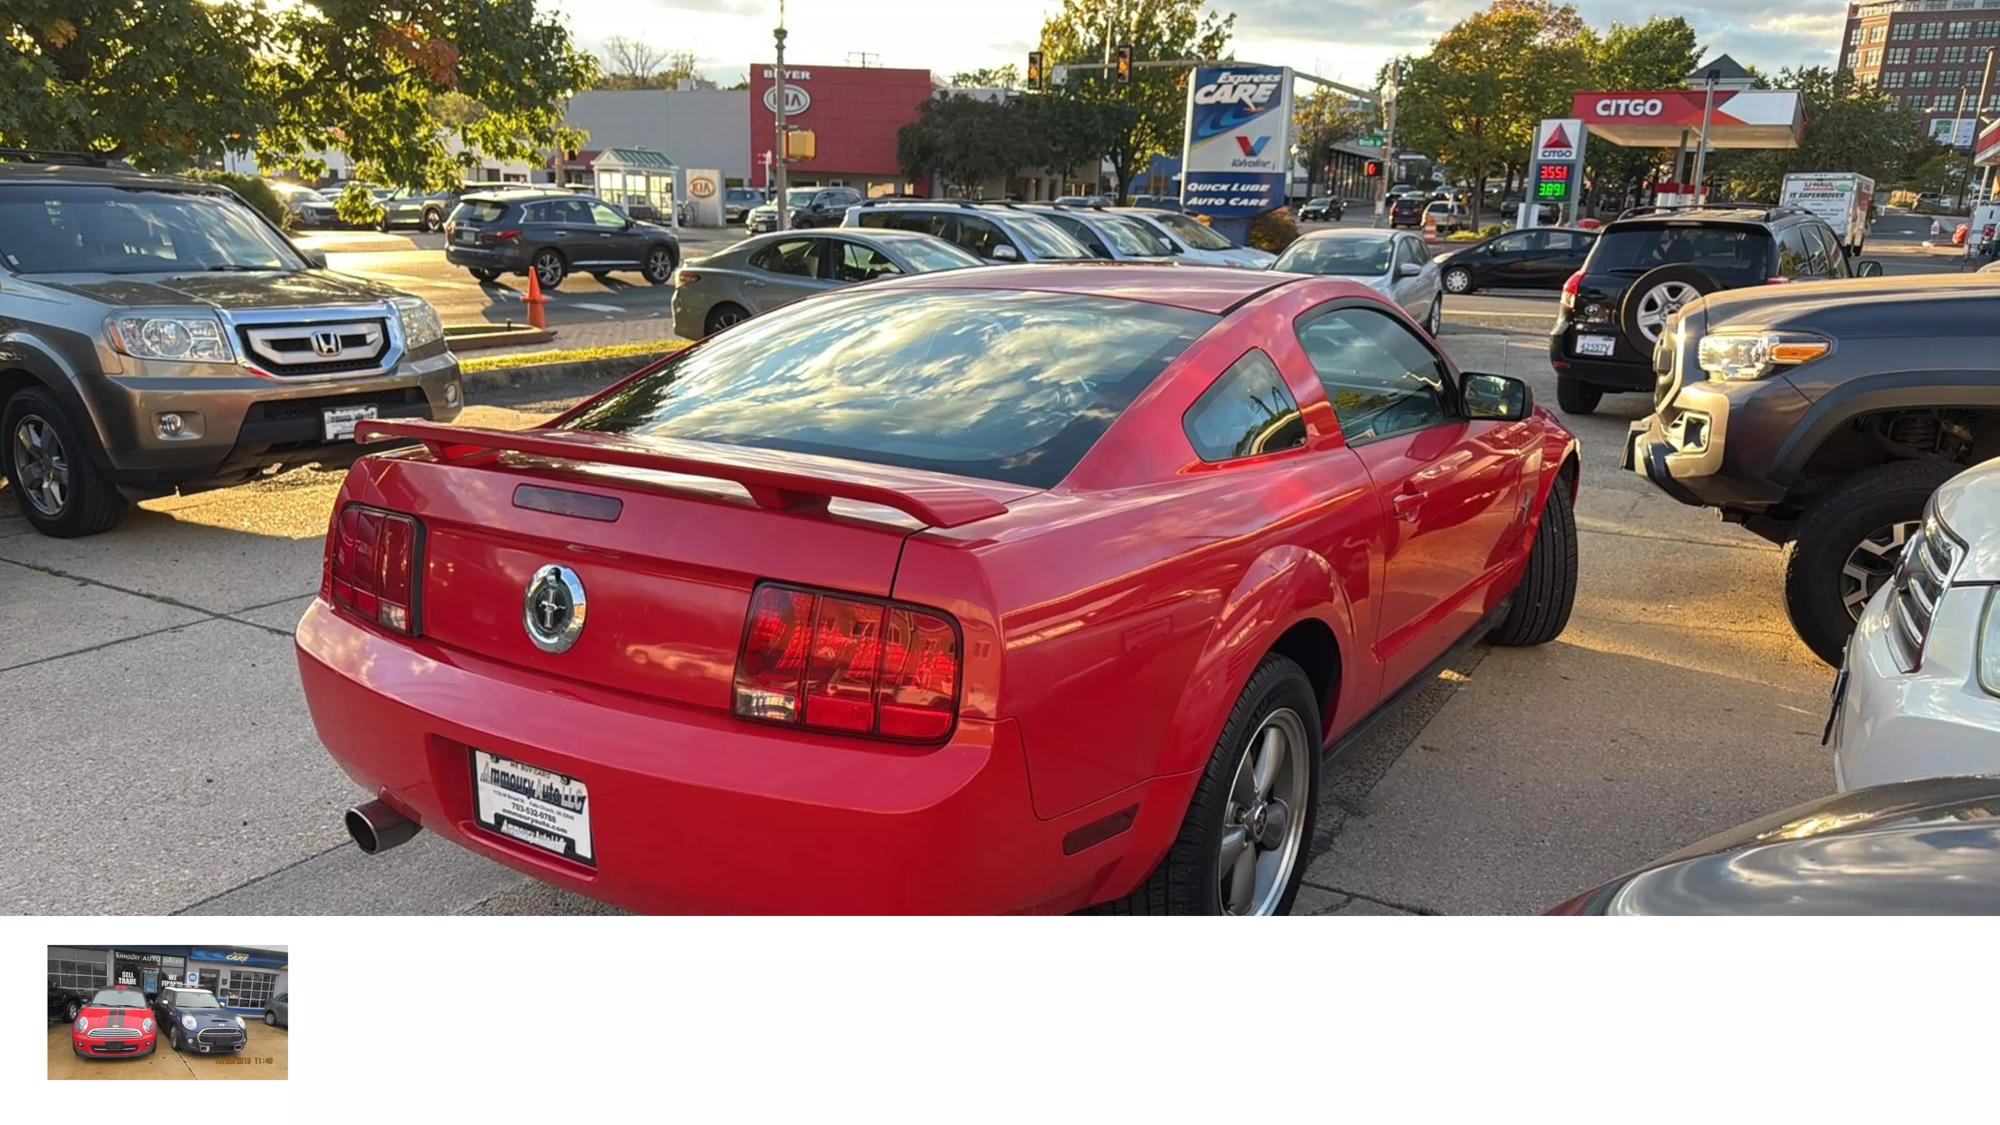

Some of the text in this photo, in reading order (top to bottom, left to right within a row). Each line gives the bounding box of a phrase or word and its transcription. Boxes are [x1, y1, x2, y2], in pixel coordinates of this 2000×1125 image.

[763, 70, 811, 80] BYER
[1217, 72, 1282, 85] Express
[1195, 83, 1278, 111] CARE
[1596, 98, 1663, 117] CITGO
[1541, 149, 1572, 158] CITGO
[692, 180, 712, 194] KIA
[1187, 182, 1271, 193] QUICK LUBE
[1187, 196, 1270, 207] AUTO CARE
[480, 761, 534, 799] Ammoury
[535, 778, 560, 804] Auto
[226, 954, 249, 963] CARE
[122, 971, 134, 979] SELL
[168, 973, 177, 981] WE
[118, 977, 137, 985] TRADE
